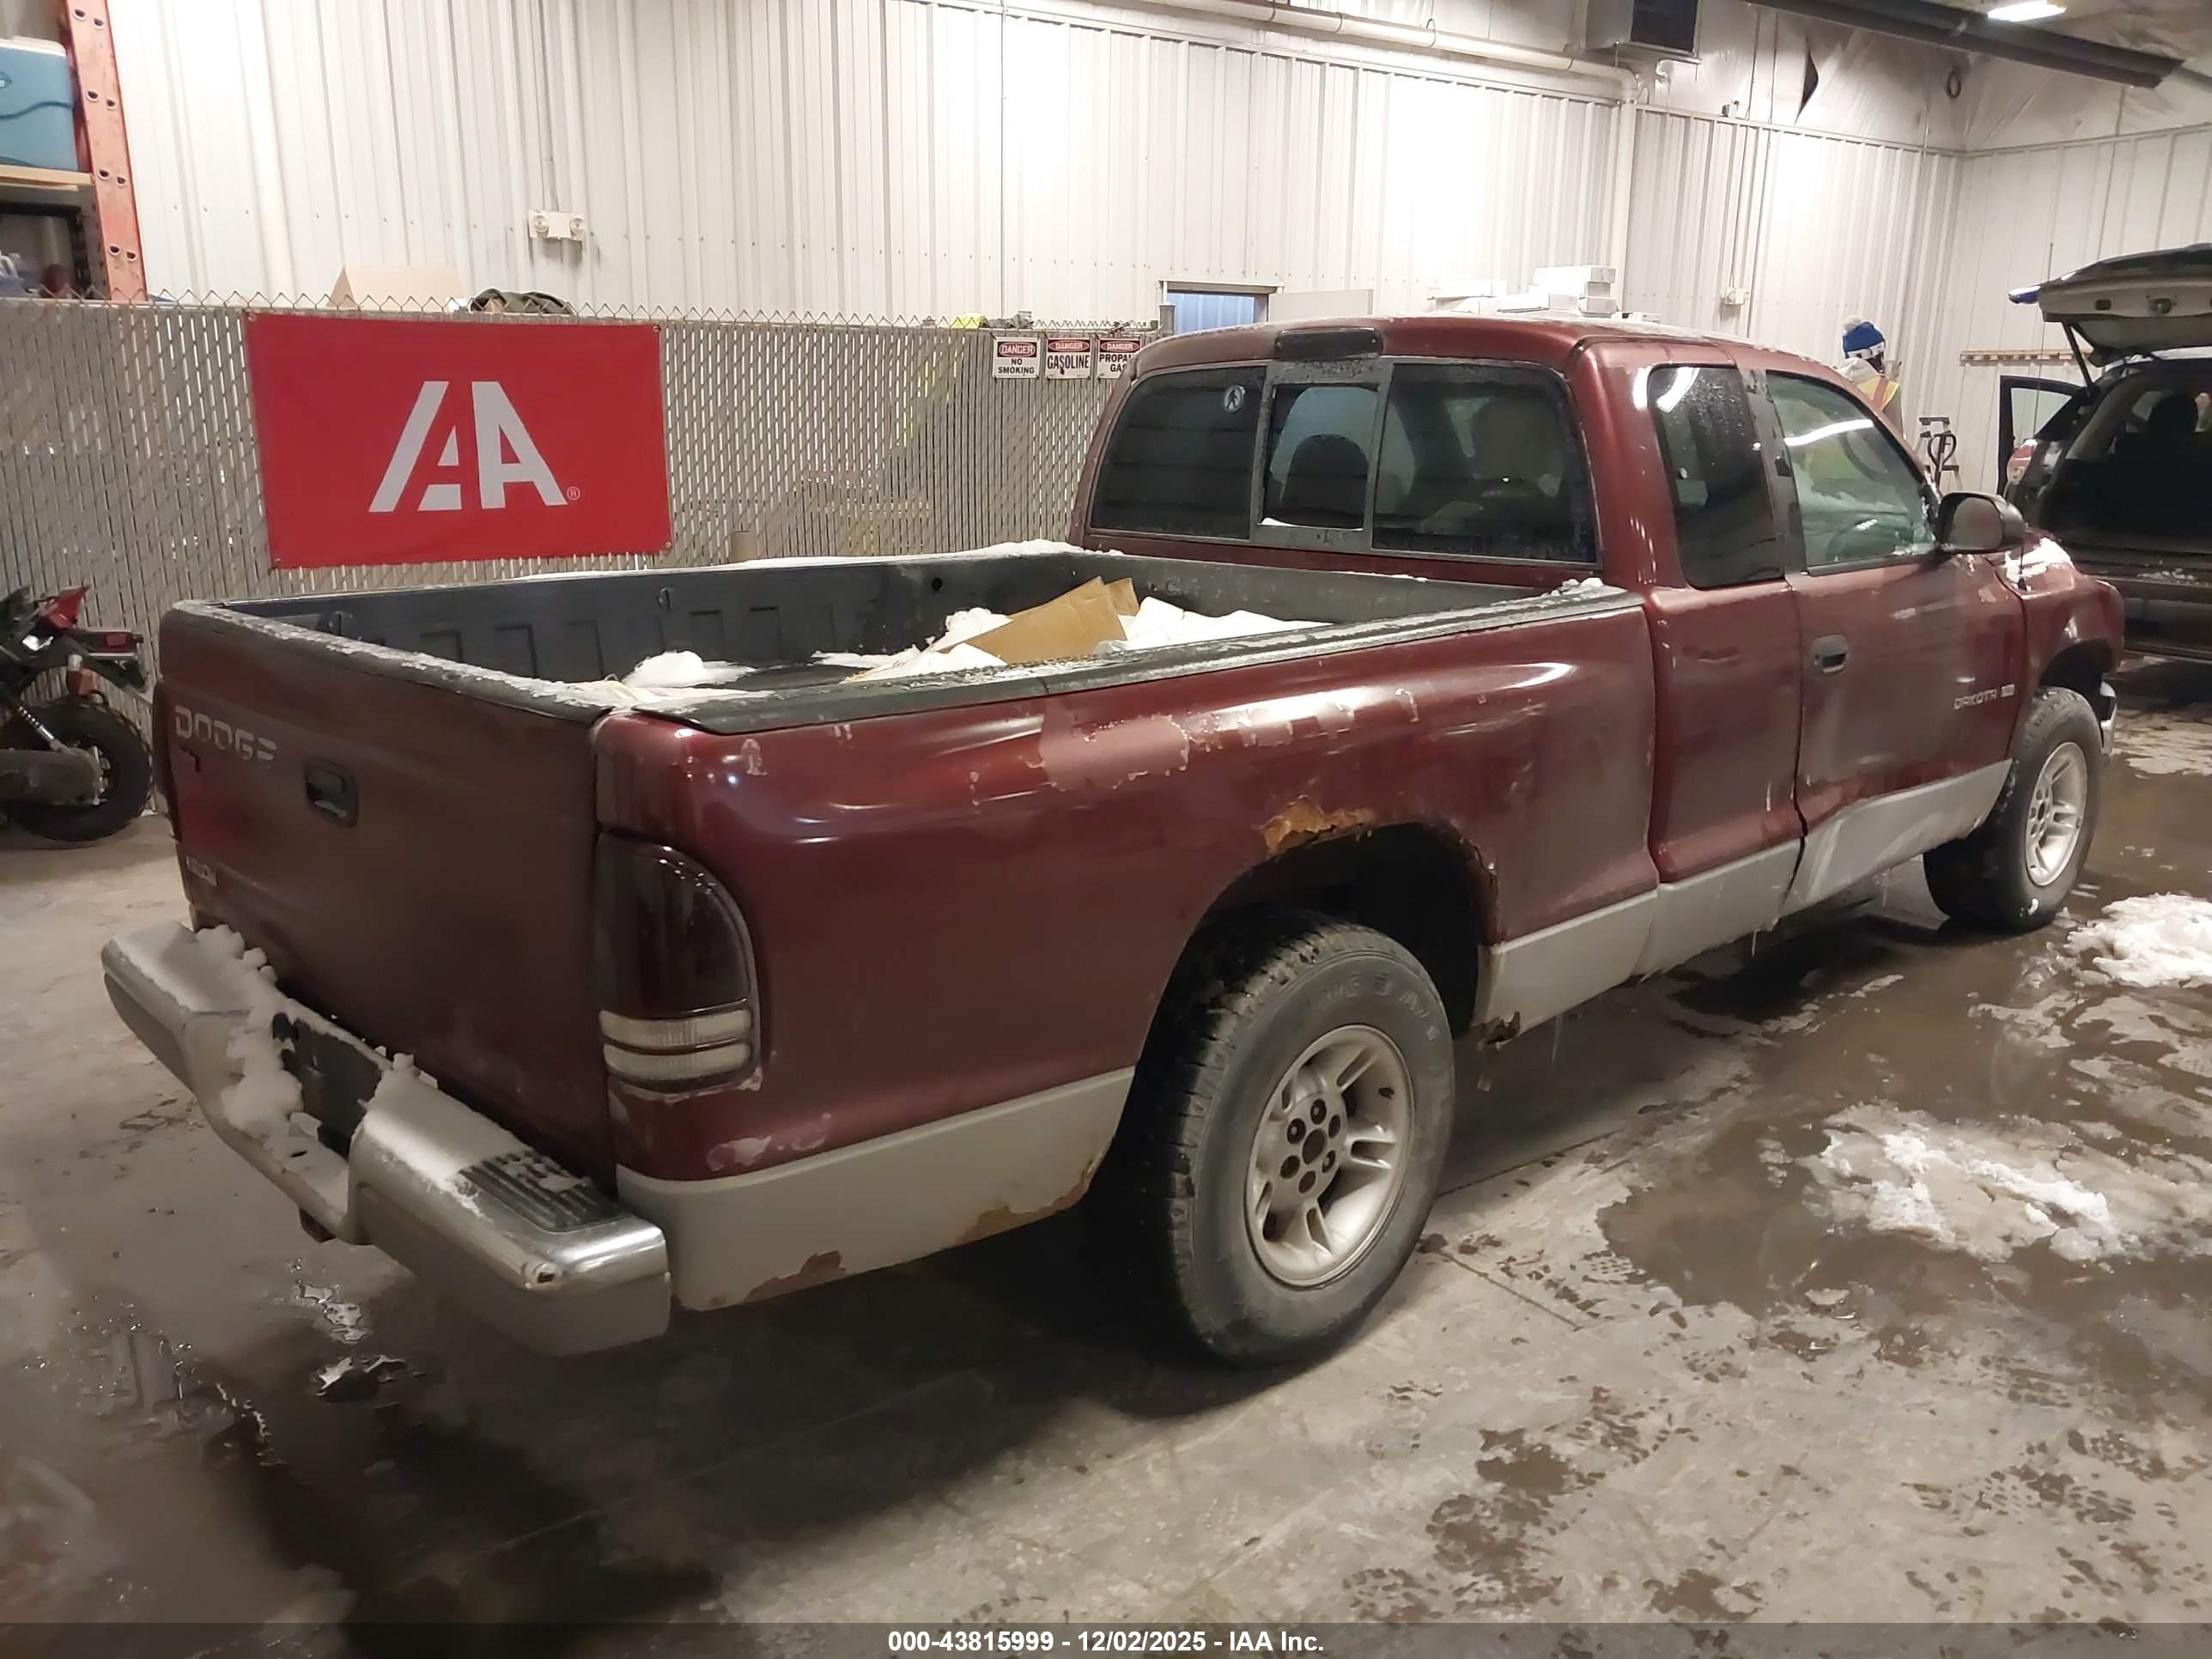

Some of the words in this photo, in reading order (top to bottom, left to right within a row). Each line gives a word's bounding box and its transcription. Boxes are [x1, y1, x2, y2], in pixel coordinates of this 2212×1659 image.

[1001, 344, 1034, 355] DANGER
[1054, 341, 1083, 349] DANGER
[1106, 342, 1134, 351] DANGER
[1011, 357, 1023, 366] NO
[1047, 354, 1090, 369] GASOLINE
[1098, 353, 1133, 362] PROPA
[997, 366, 1035, 374] SMOKING
[174, 704, 277, 762] DODGE
